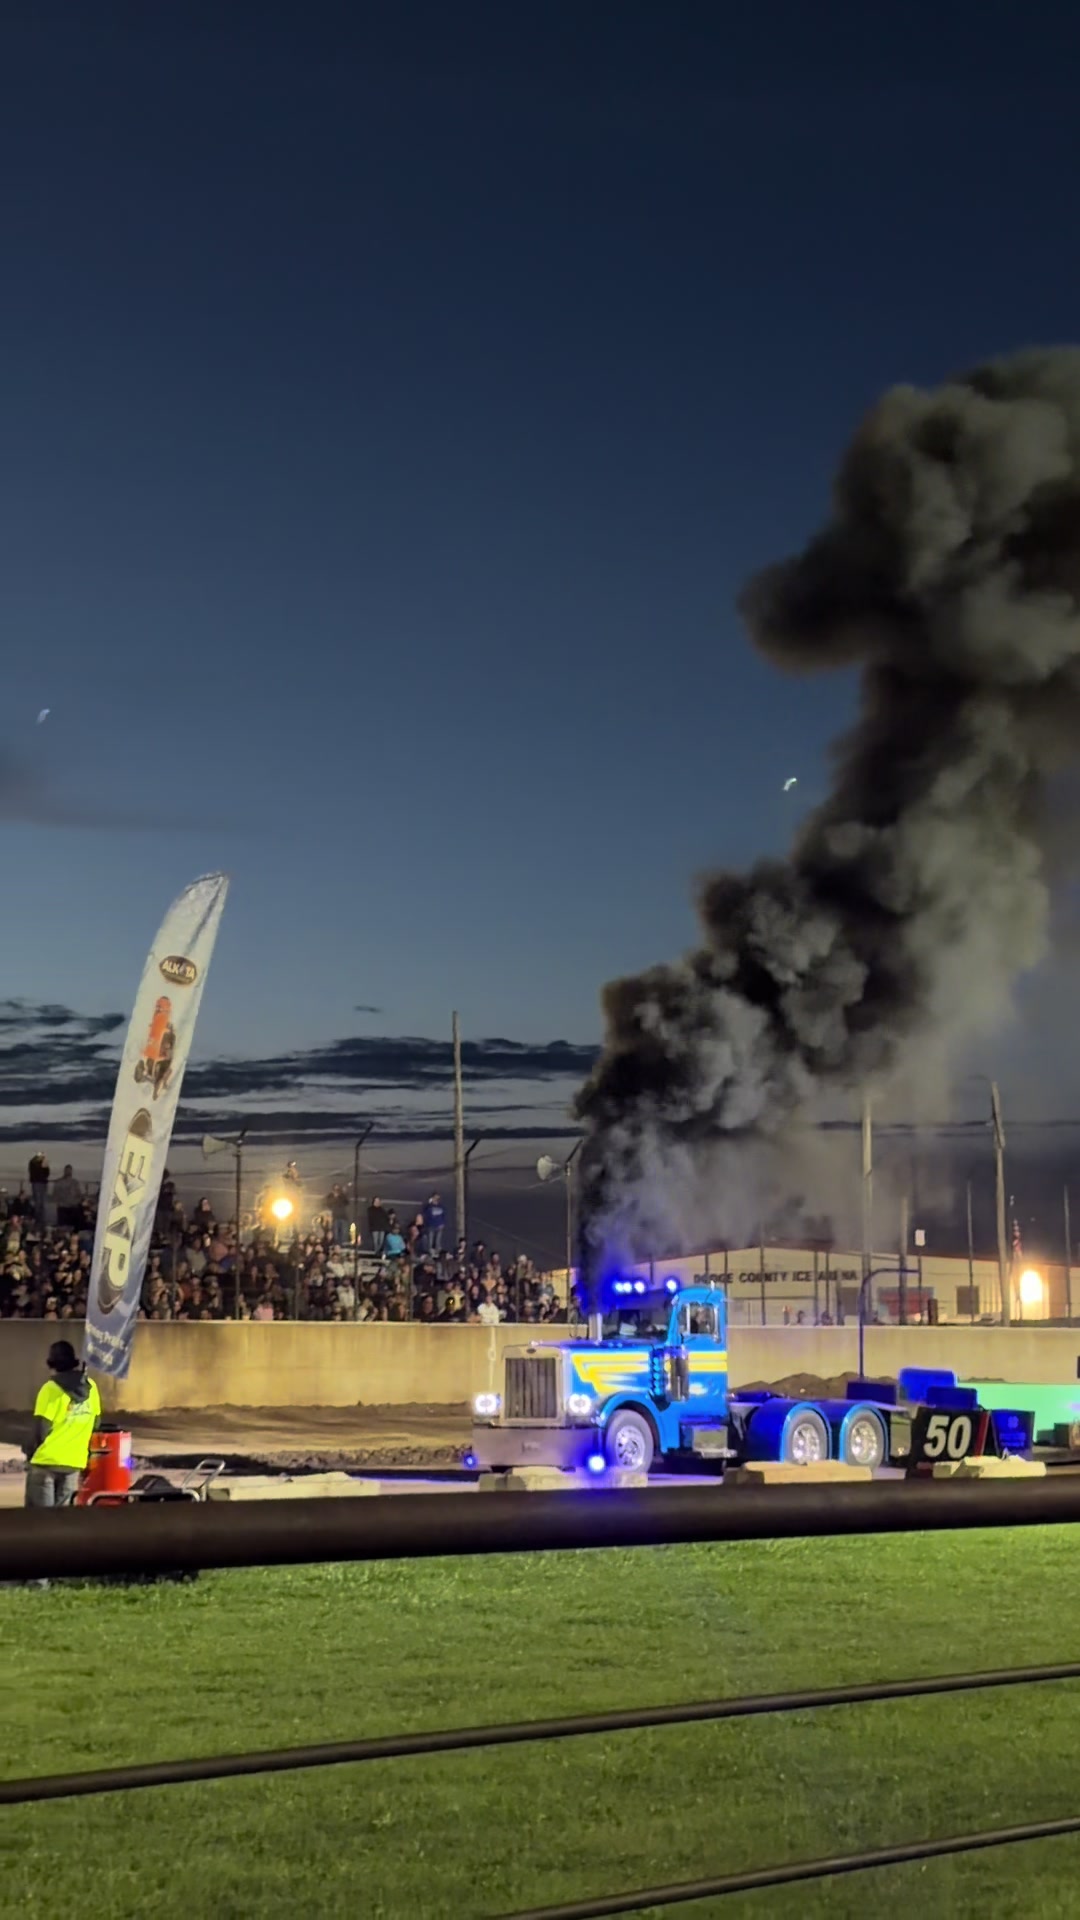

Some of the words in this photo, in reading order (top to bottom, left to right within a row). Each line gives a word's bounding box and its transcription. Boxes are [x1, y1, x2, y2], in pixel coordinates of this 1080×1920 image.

[739, 1271, 787, 1283] COUNTY
[792, 1271, 813, 1282] ICE
[923, 1415, 972, 1459] 50
